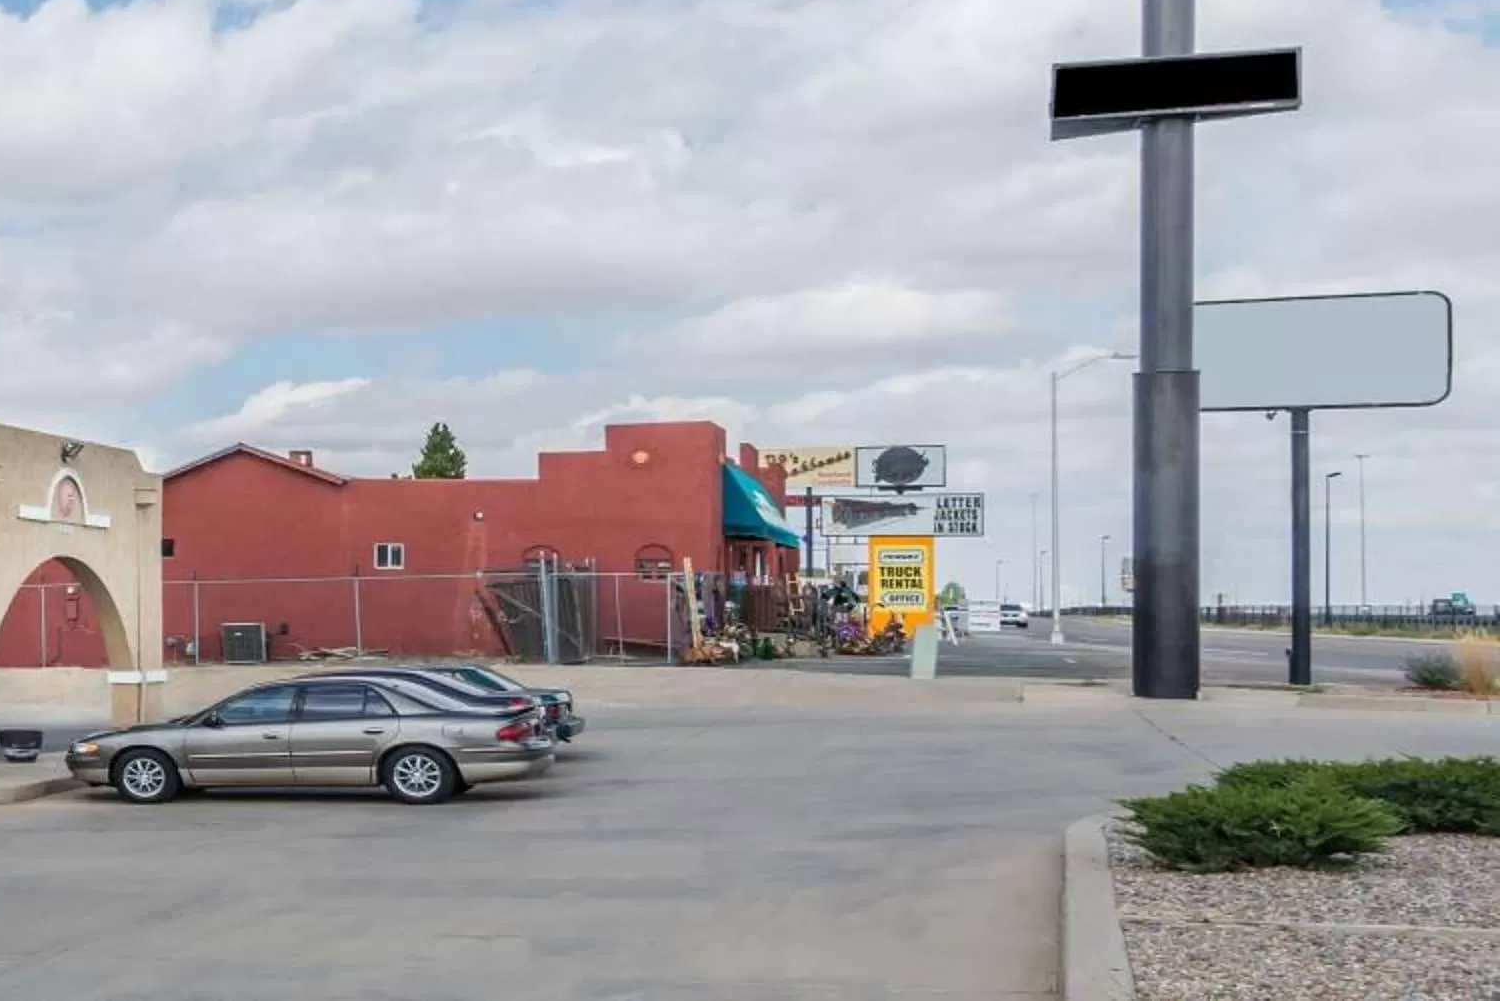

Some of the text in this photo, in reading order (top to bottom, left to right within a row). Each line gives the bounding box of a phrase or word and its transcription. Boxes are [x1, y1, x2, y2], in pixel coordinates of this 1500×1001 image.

[936, 497, 981, 508] LETTER
[933, 509, 978, 521] JACKETS
[933, 522, 977, 533] IN STOCK
[879, 566, 922, 577] TRUCK
[880, 578, 924, 589] RENTAL
[888, 594, 919, 602] OFFICE
